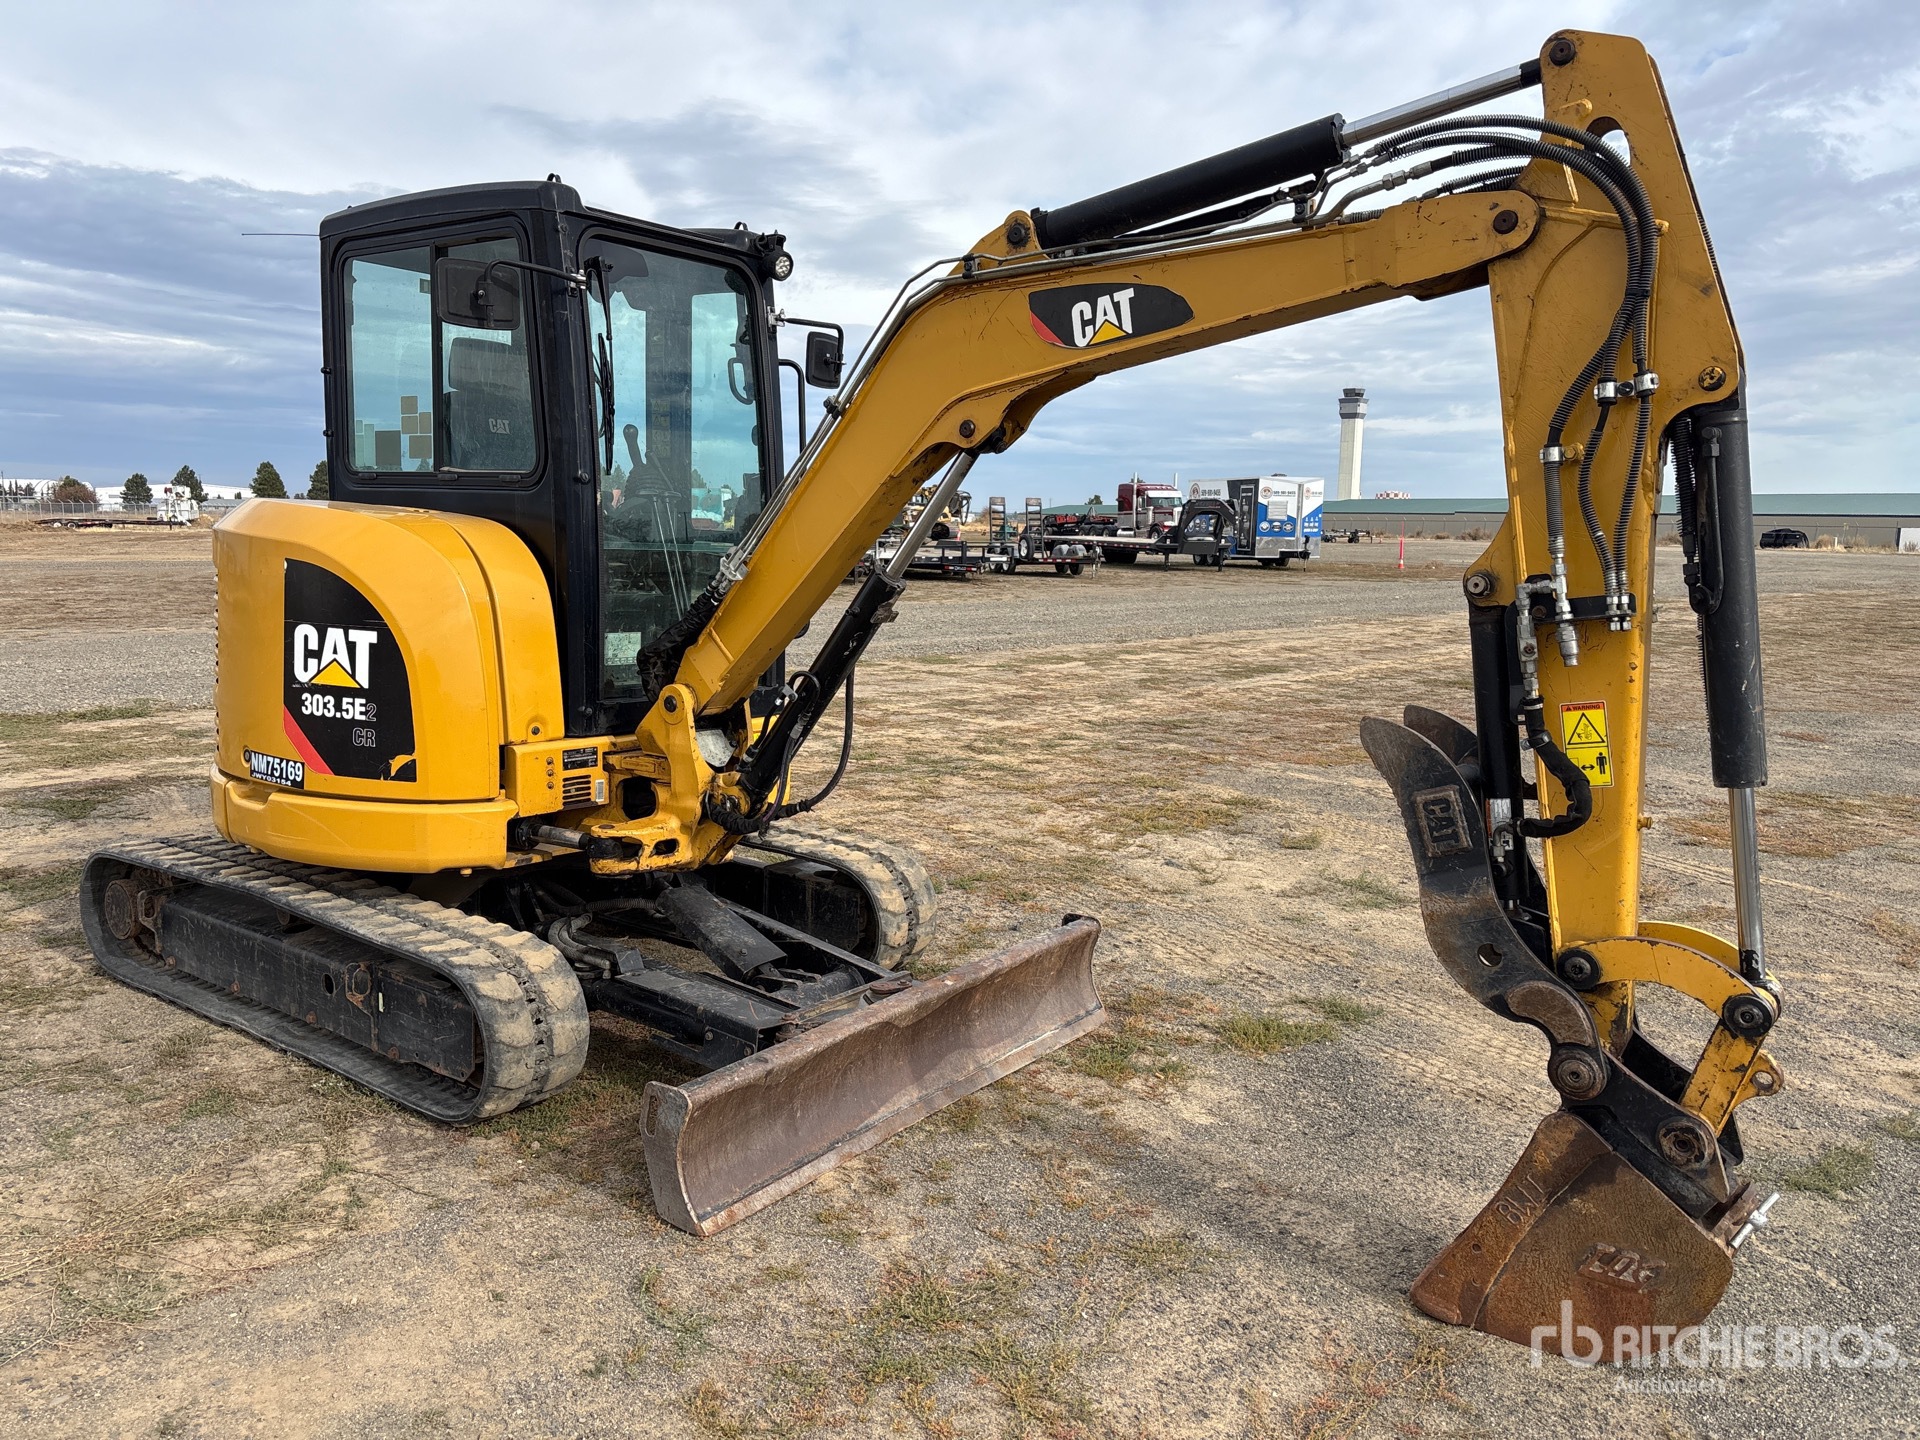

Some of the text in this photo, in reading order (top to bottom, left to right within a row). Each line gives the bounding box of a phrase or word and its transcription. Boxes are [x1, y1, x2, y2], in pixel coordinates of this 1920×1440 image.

[1071, 287, 1135, 347] CAT
[488, 417, 512, 435] CAT
[293, 623, 378, 689] CAT
[301, 692, 377, 722] 303.5E2
[352, 727, 376, 748] CR
[251, 752, 303, 782] NM75169
[251, 772, 292, 787] JWY03154
[1422, 798, 1460, 844] CAT
